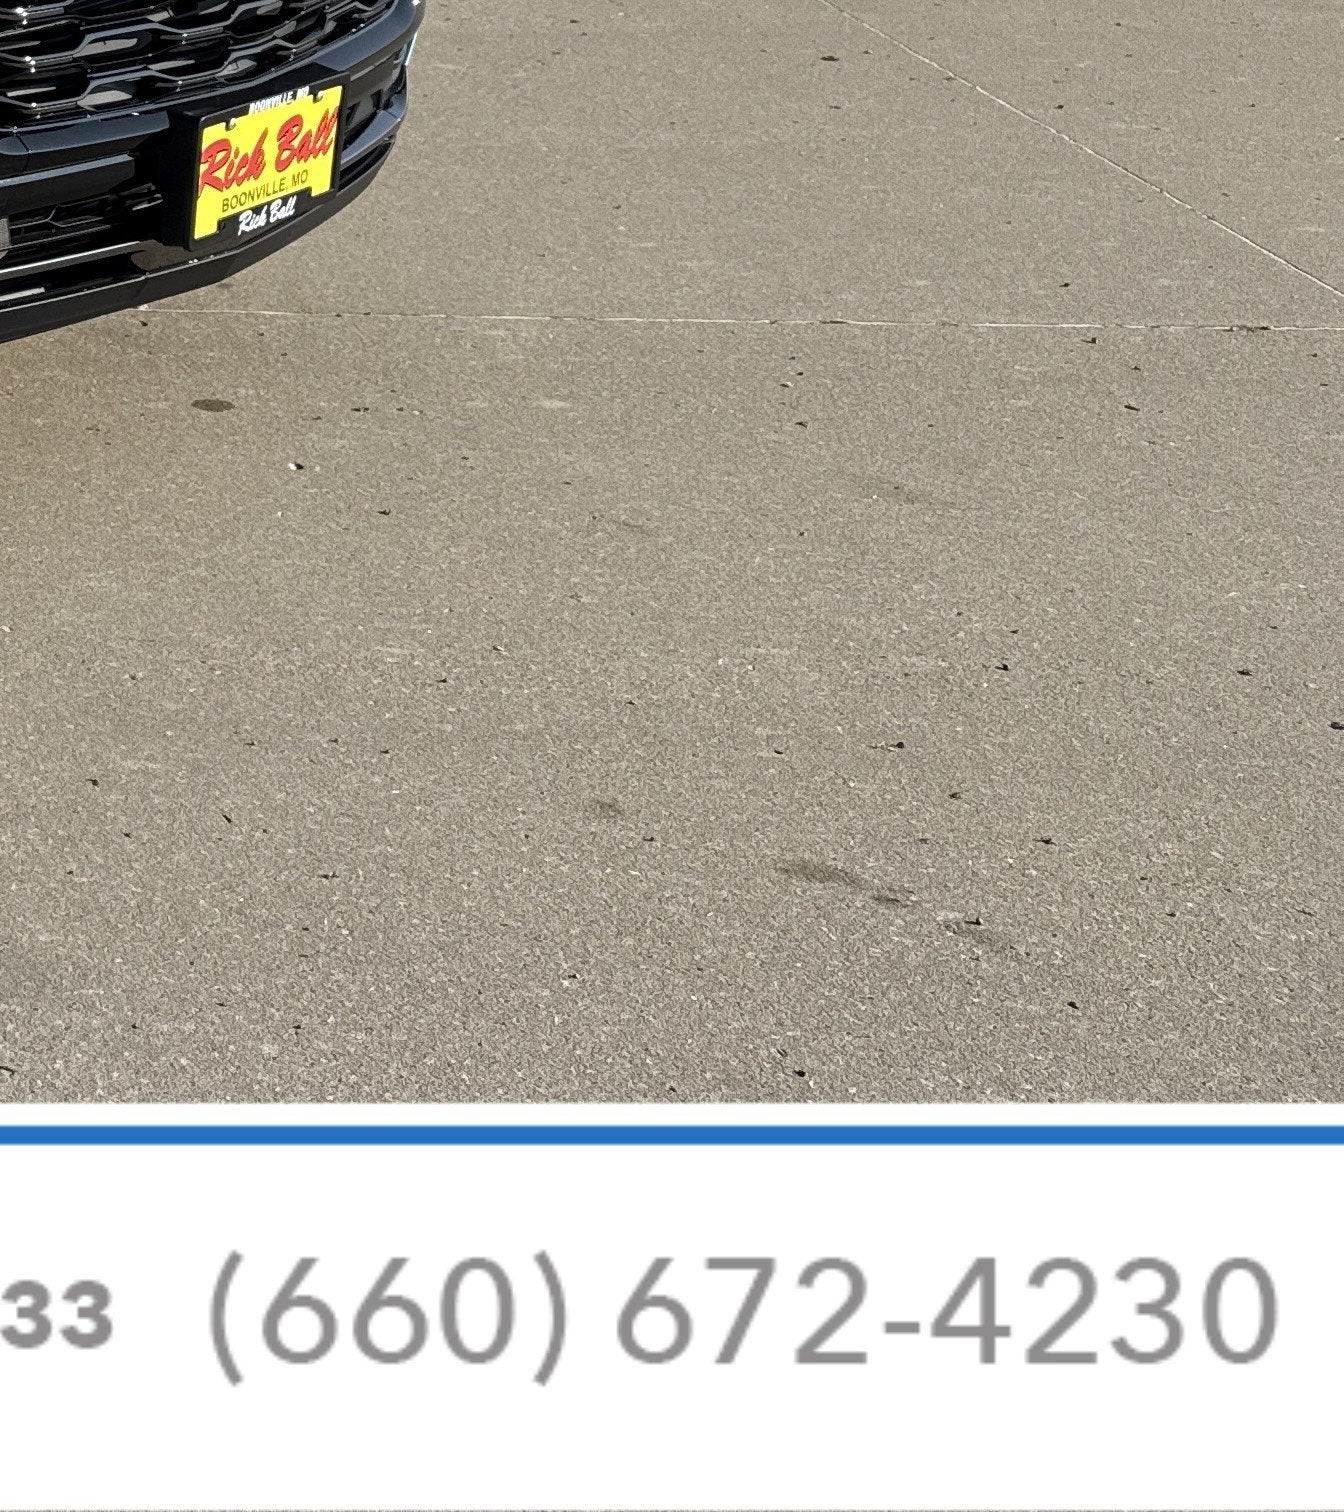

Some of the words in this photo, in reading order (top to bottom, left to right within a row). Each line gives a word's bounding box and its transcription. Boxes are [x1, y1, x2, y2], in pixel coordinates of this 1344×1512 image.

[198, 127, 268, 198] Rick
[275, 107, 339, 172] Ball
[221, 178, 290, 213] BOONVILLE,
[291, 171, 309, 189] MO
[237, 211, 267, 236] Rick
[269, 196, 296, 223] Ball
